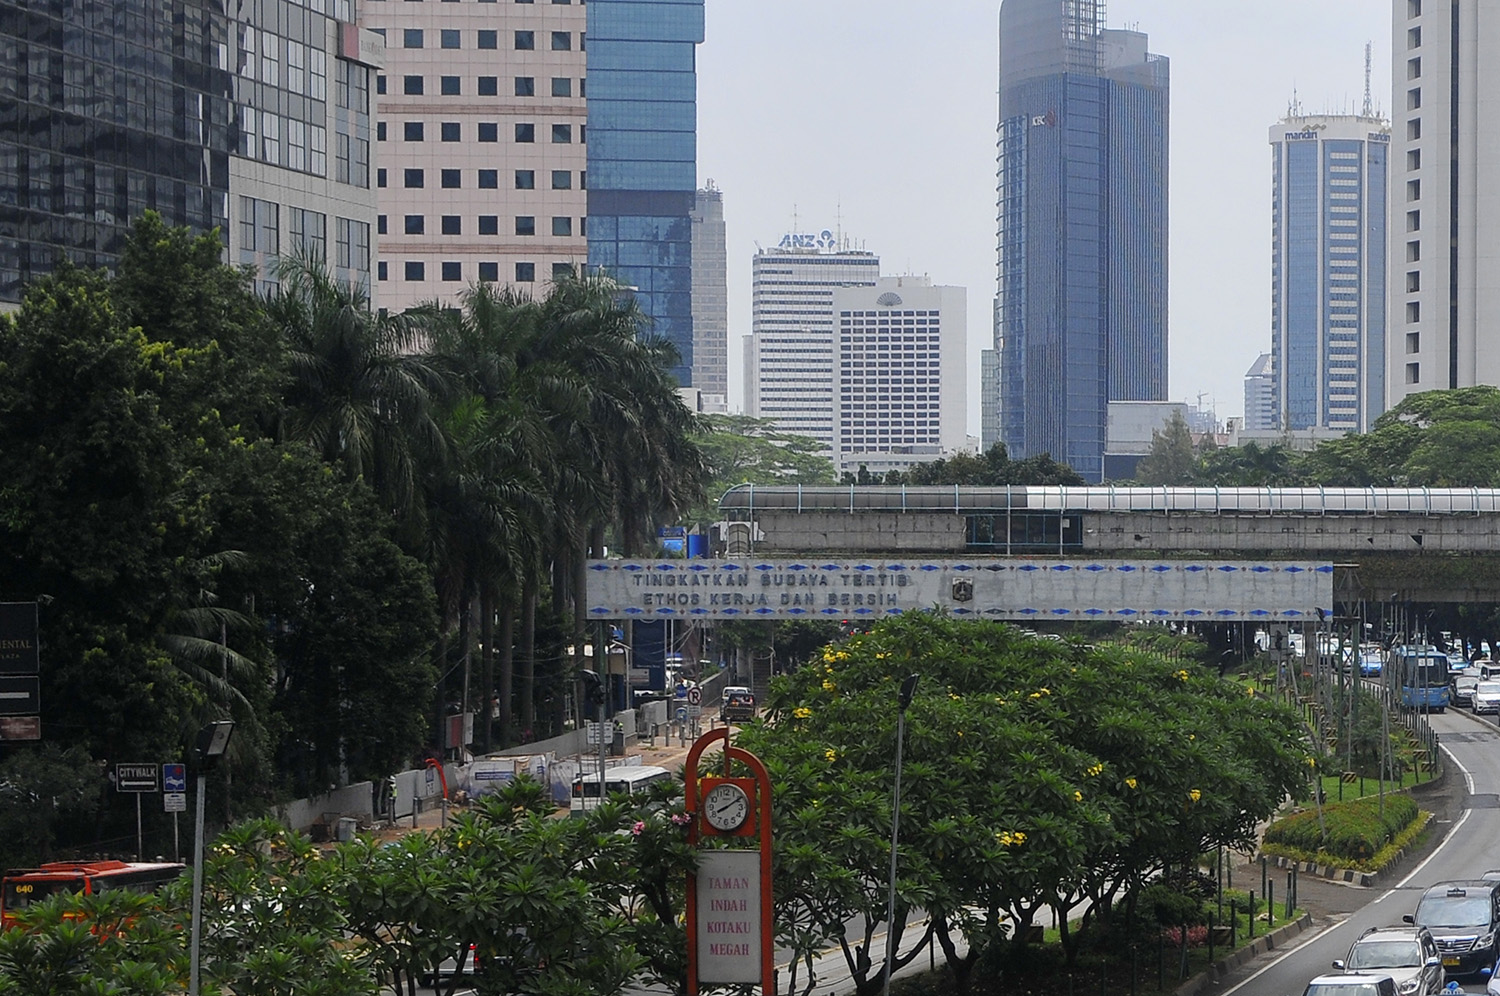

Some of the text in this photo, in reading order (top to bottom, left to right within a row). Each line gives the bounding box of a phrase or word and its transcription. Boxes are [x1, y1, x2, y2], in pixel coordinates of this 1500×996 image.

[1285, 129, 1318, 140] mandiri
[779, 234, 815, 247] ANZ
[633, 574, 748, 587] TINGKATKAN
[761, 574, 828, 587] BUDAYA
[643, 593, 898, 606] ETHOS KERJA DAN BERSIH
[119, 767, 156, 778] CITYWALK
[16, 885, 33, 893] 640
[707, 877, 750, 889] TAMAN
[710, 899, 748, 912] INDAH
[707, 921, 751, 934] KOTAKU
[710, 944, 750, 956] MEGAH
